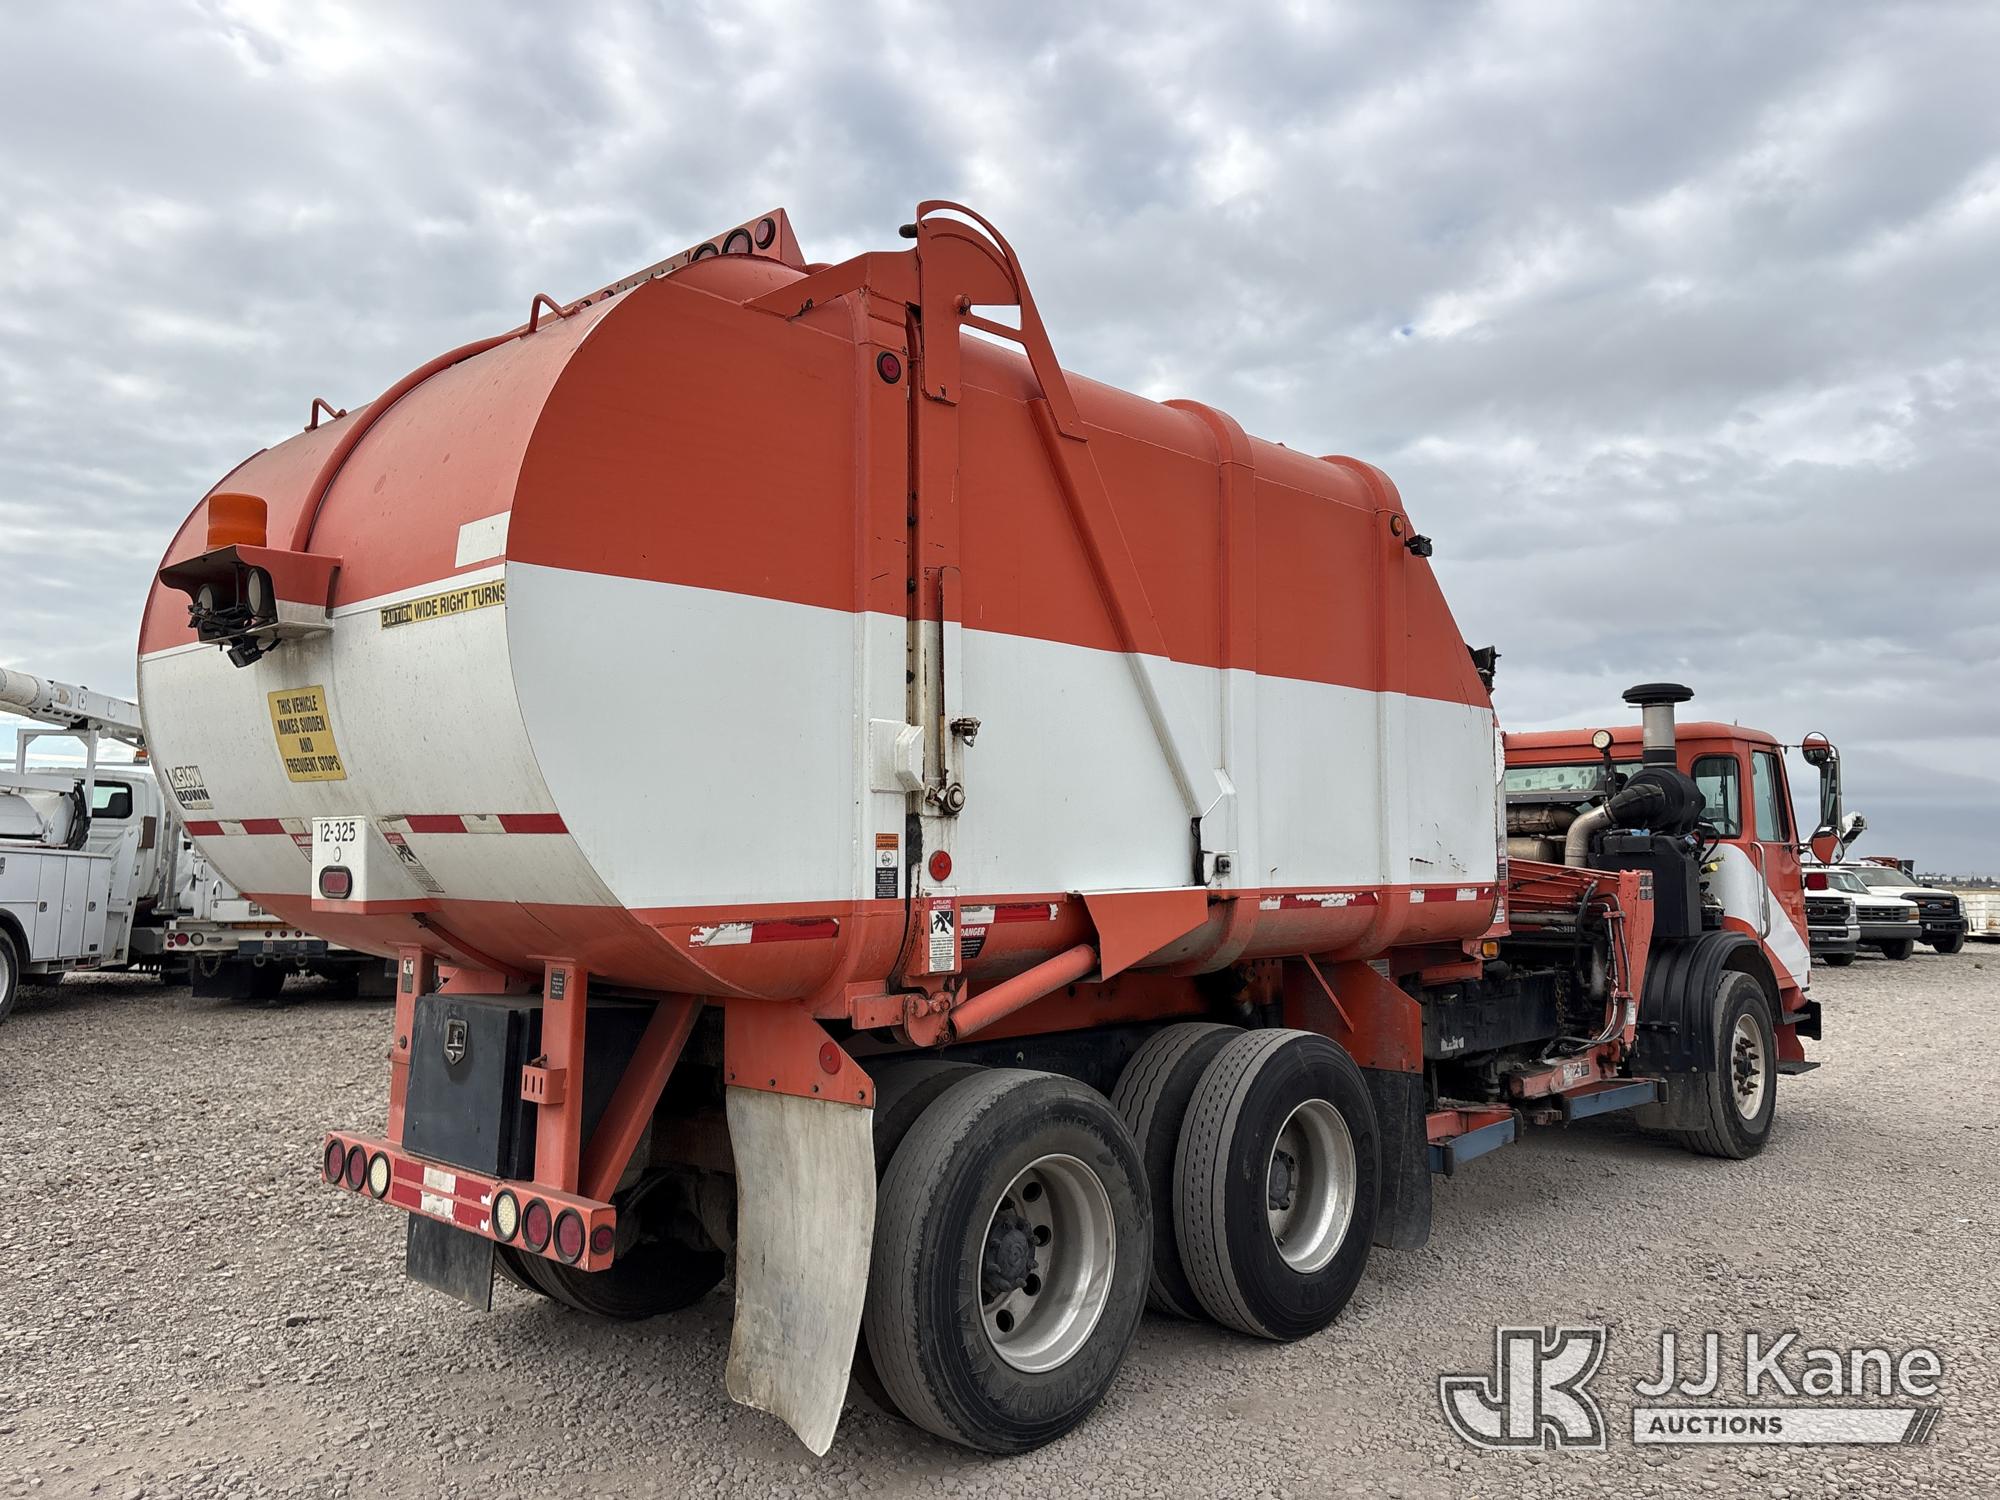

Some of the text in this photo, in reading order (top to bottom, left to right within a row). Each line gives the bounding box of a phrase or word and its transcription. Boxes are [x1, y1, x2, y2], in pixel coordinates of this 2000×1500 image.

[381, 583, 505, 626] CAUTION WIDE RIGHT TURNS
[277, 695, 318, 715] THIS VEHICLE
[277, 715, 326, 735] MAKES SUDDEN
[299, 737, 314, 753] AND
[286, 755, 341, 774] FREQUENT STOPS
[177, 788, 210, 801] DOWN
[320, 822, 356, 843] 12-325
[960, 927, 986, 937] DANGER
